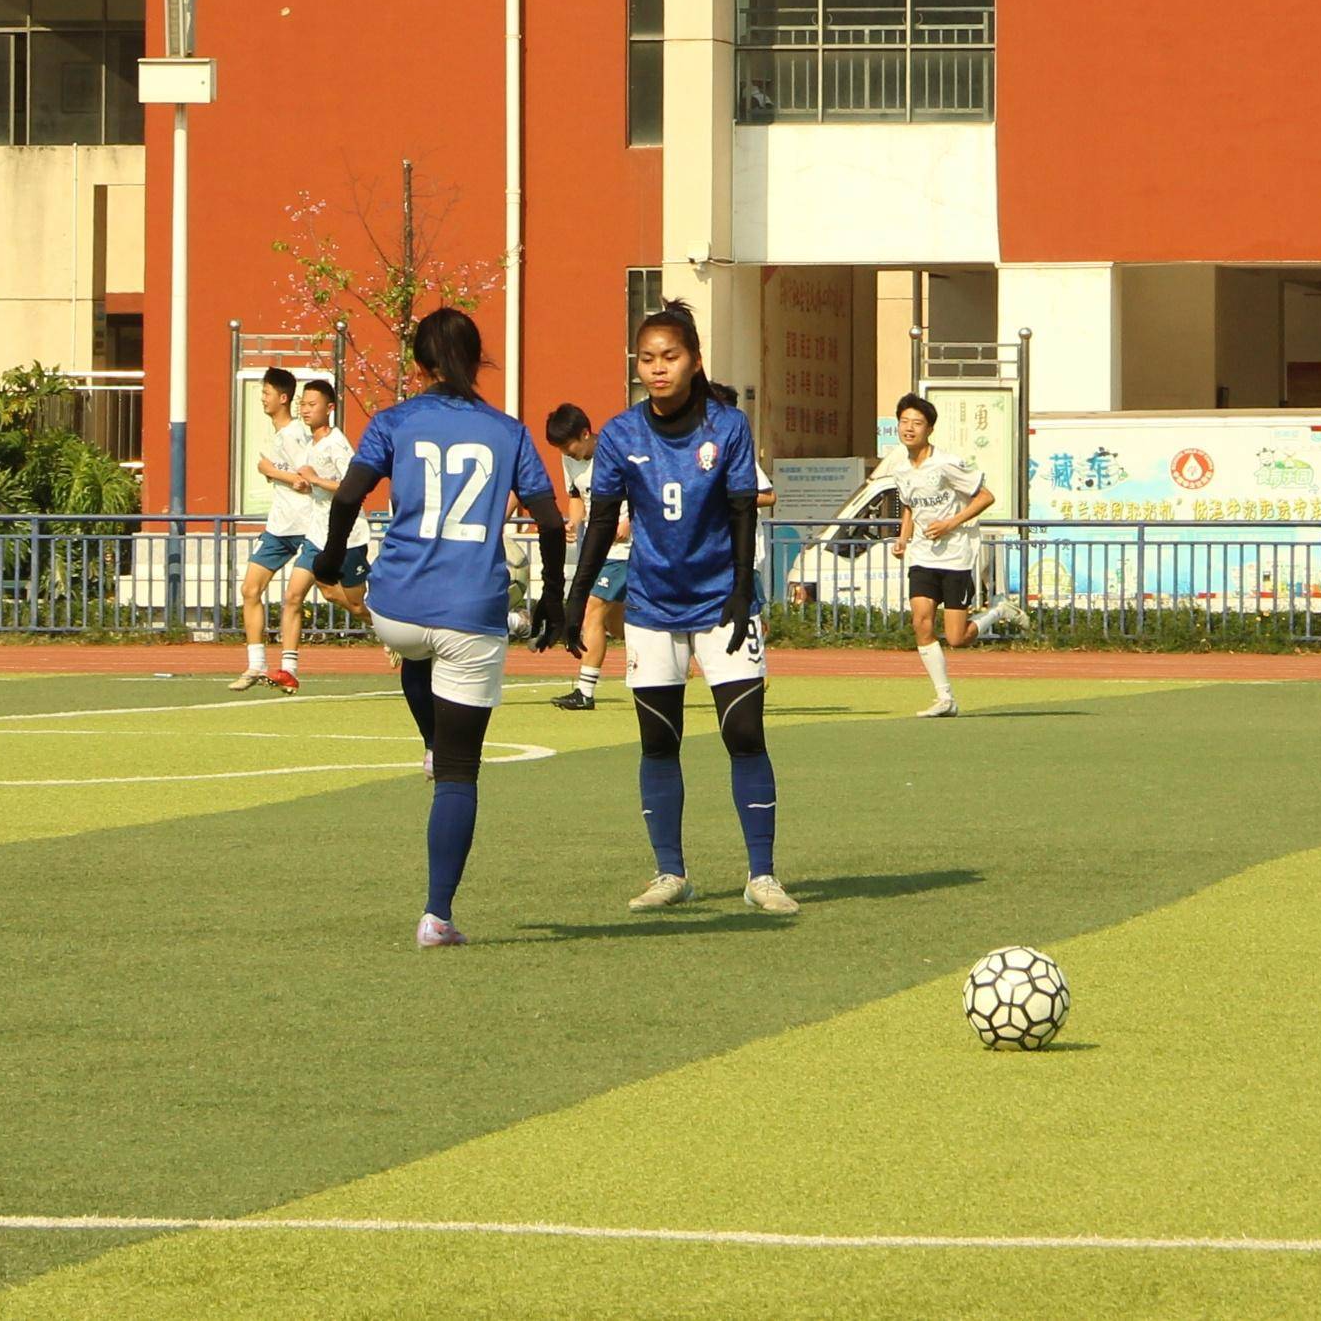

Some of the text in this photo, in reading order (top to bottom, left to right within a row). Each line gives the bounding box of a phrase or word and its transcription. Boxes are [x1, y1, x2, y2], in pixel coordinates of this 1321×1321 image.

[414, 441, 494, 543] 12
[661, 482, 683, 521] 9
[745, 618, 760, 655] 9
